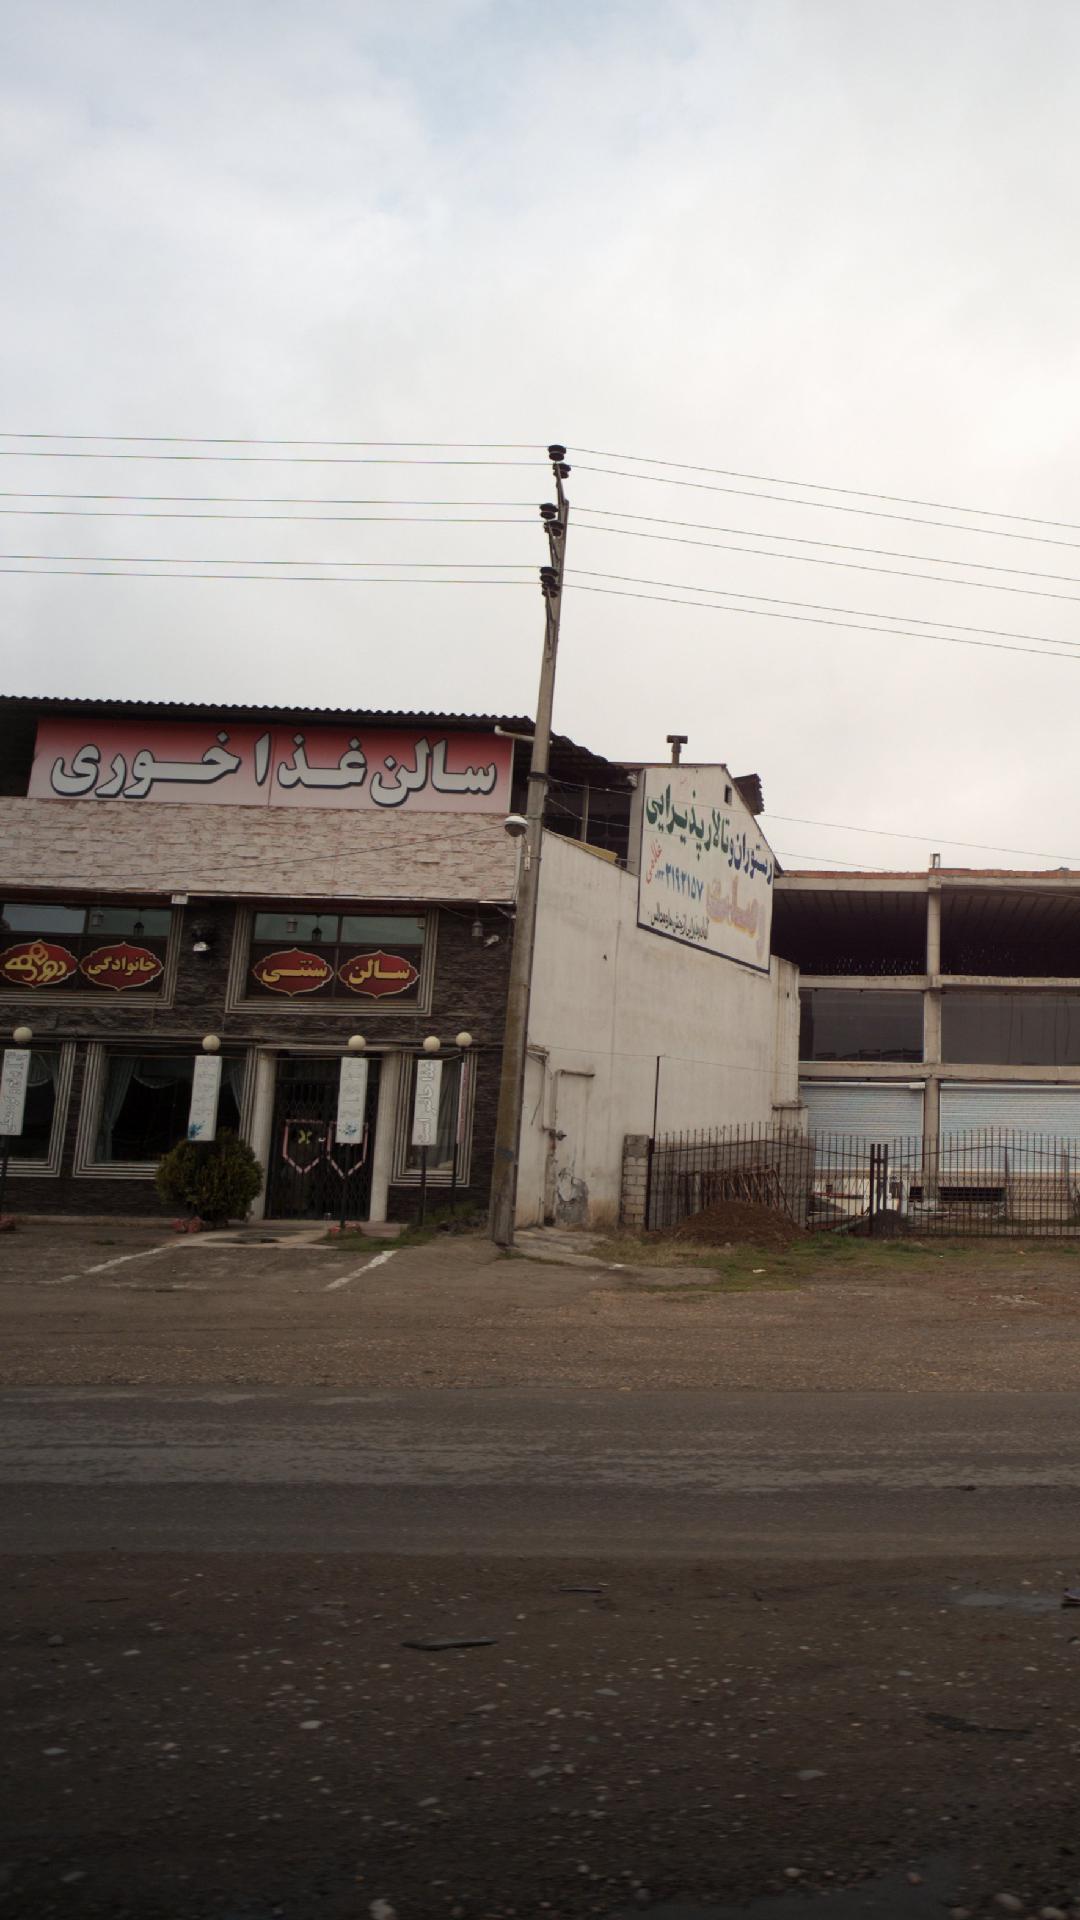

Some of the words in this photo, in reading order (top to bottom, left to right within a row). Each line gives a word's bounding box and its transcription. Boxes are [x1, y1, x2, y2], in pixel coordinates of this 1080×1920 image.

[370, 737, 497, 807] سالن
[646, 784, 705, 861] پذیرایی
[87, 955, 157, 976] خانوادگی
[262, 959, 329, 983] سنتی
[349, 949, 411, 985] سالن
